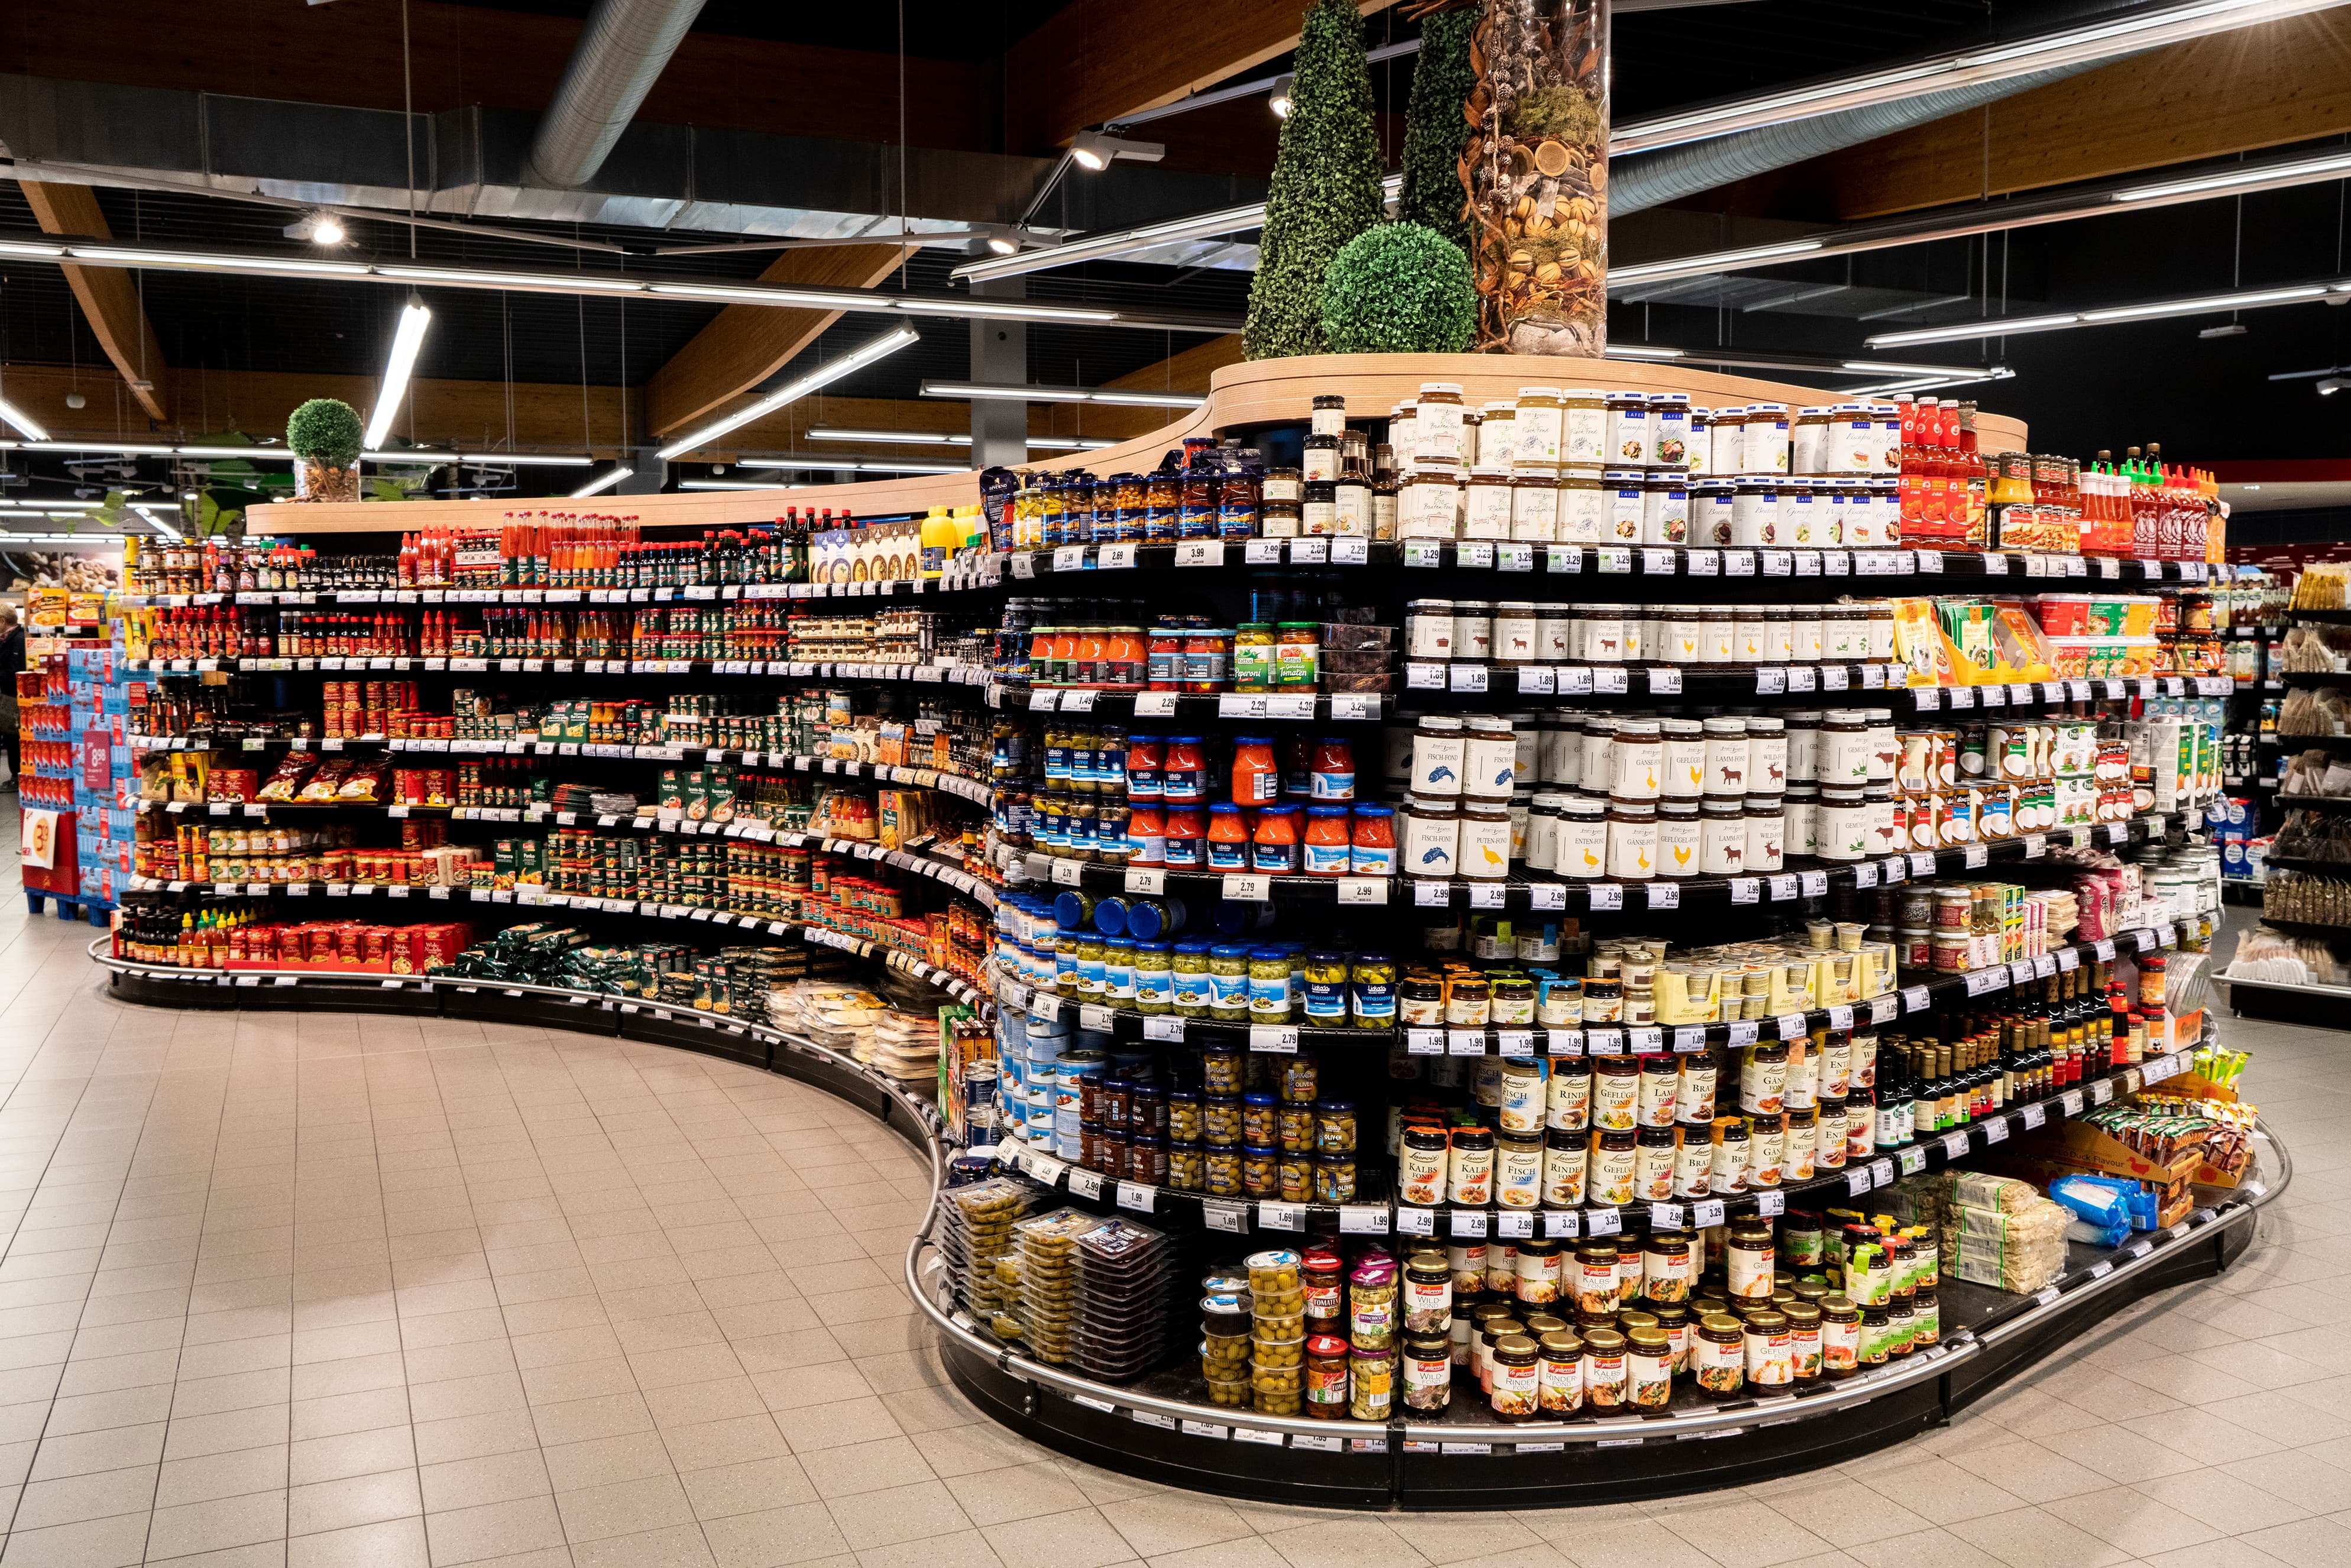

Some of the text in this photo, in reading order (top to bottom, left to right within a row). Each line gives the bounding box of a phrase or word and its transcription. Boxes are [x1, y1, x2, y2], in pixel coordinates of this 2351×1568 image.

[1191, 549, 1204, 557] 3.99
[1264, 546, 1278, 554] 2.99
[1424, 550, 1439, 559] 3.29
[1476, 549, 1491, 558] 3.29
[1112, 551, 1123, 559] 2.69
[1518, 553, 1532, 562] 3.29
[1616, 555, 1630, 564] 3.29
[1566, 555, 1581, 565] 3.29
[1662, 556, 1675, 565] 2.99
[1705, 557, 1717, 566] 2.99
[1741, 558, 1753, 566] 2.99
[1778, 557, 1789, 566] 2.99
[1809, 558, 1820, 567] 2.99
[1838, 558, 1847, 567] 2.99
[1235, 668, 1261, 678] Peperoni
[1280, 668, 1307, 676] Tomaten
[1429, 670, 1444, 680] 1.89
[1472, 674, 1485, 683] 1.89
[1539, 676, 1553, 685] 1.89
[1577, 675, 1591, 685] 1.89
[1613, 675, 1627, 685] 1.89
[1162, 699, 1174, 707] 2.29
[1252, 701, 1265, 710] 2.29
[1298, 701, 1312, 711] 4.39
[1925, 858, 1935, 867] 2.19
[1063, 868, 1071, 877] 2.79
[1868, 870, 1877, 879] 2.99
[1139, 876, 1151, 886] 2.79
[1816, 877, 1826, 886] 2.99
[1241, 882, 1254, 892] 2.79
[1357, 886, 1372, 895] 2.99
[1747, 885, 1759, 894] 2.99
[1786, 882, 1796, 890] 2.99
[1434, 889, 1448, 898] 2.99
[1490, 890, 1504, 900] 2.99
[1551, 893, 1565, 902] 2.99
[1608, 892, 1621, 901] 2.99
[1665, 891, 1678, 900] 2.99
[2046, 960, 2055, 968] 2.19
[1999, 971, 2008, 980] 4.99
[1979, 978, 1988, 986] 2.39
[1042, 1002, 1051, 1012] 3.49
[1102, 1014, 1112, 1023] 2.79
[1170, 1025, 1182, 1034] 2.79
[1794, 1021, 1805, 1031] 1.09
[1283, 1034, 1296, 1044] 2.79
[1648, 1034, 1661, 1044] 9.99
[1746, 1029, 1757, 1040] 1.09
[1428, 1036, 1443, 1046] 1.99
[1469, 1038, 1483, 1047] 1.99
[1519, 1039, 1533, 1048] 1.99
[1568, 1038, 1582, 1047] 1.99
[1608, 1038, 1621, 1047] 1.99
[1692, 1035, 1704, 1045] 1.09
[1502, 1087, 1527, 1099] FISCH
[2094, 1156, 2124, 1167] Flavour
[1409, 1162, 1437, 1173] KALBS
[1462, 1164, 1489, 1173] KALBS
[1508, 1165, 1536, 1175] FISCH
[1551, 1163, 1584, 1173] RINDER
[1086, 1180, 1099, 1191] 2.99
[1131, 1191, 1142, 1203] 1.99
[1278, 1212, 1292, 1222] 1.69
[1669, 1212, 1682, 1222] 2.99
[1709, 1207, 1722, 1218] 3.29
[1223, 1217, 1236, 1226] 1.69
[1373, 1216, 1387, 1226] 1.99
[1417, 1216, 1432, 1226] 2.99
[1605, 1213, 1619, 1225] 3.29
[1471, 1219, 1485, 1229] 2.99
[1518, 1220, 1532, 1230] 2.99
[1562, 1219, 1576, 1229] 3.29
[1313, 1298, 1339, 1307] TOMATEN
[1546, 1373, 1578, 1382] RINDER-
